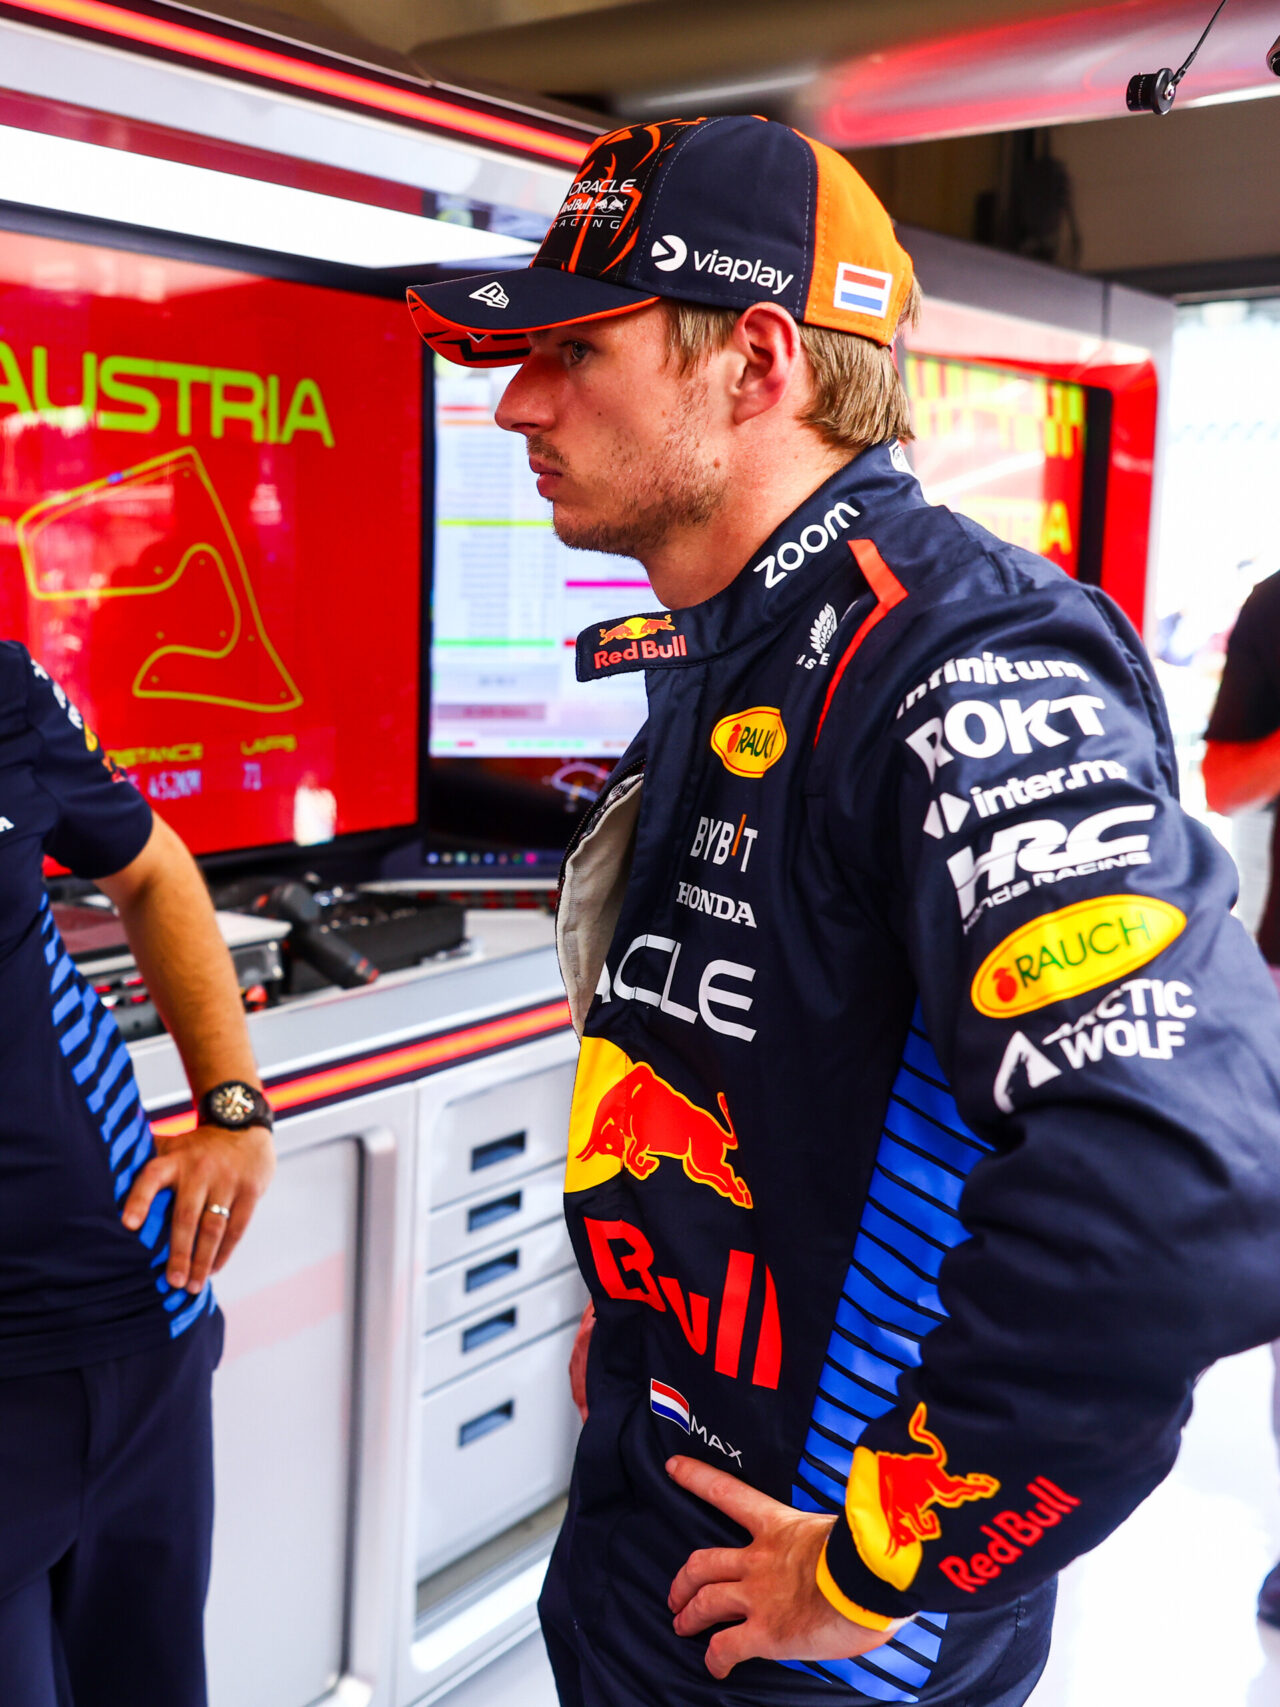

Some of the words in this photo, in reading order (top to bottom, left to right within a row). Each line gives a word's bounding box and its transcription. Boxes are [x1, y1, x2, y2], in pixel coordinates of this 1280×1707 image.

[569, 178, 637, 197] ORACLE
[693, 248, 795, 296] viaplay
[753, 501, 861, 589] zoom
[593, 644, 640, 670] Red
[641, 634, 688, 660] Bull
[904, 694, 1107, 784] ROKT
[689, 813, 759, 873] BYBIT
[946, 804, 1156, 921] HRC
[1032, 851, 1153, 887] RACING
[676, 881, 758, 929] HONDA
[1014, 912, 1152, 989] RAUCH
[594, 933, 757, 1042] CLE
[1058, 1018, 1187, 1071] WOLF
[583, 1216, 783, 1391] Bull
[690, 1414, 743, 1469] MAX
[938, 1525, 1023, 1594] Red
[992, 1474, 1082, 1547] Bull
